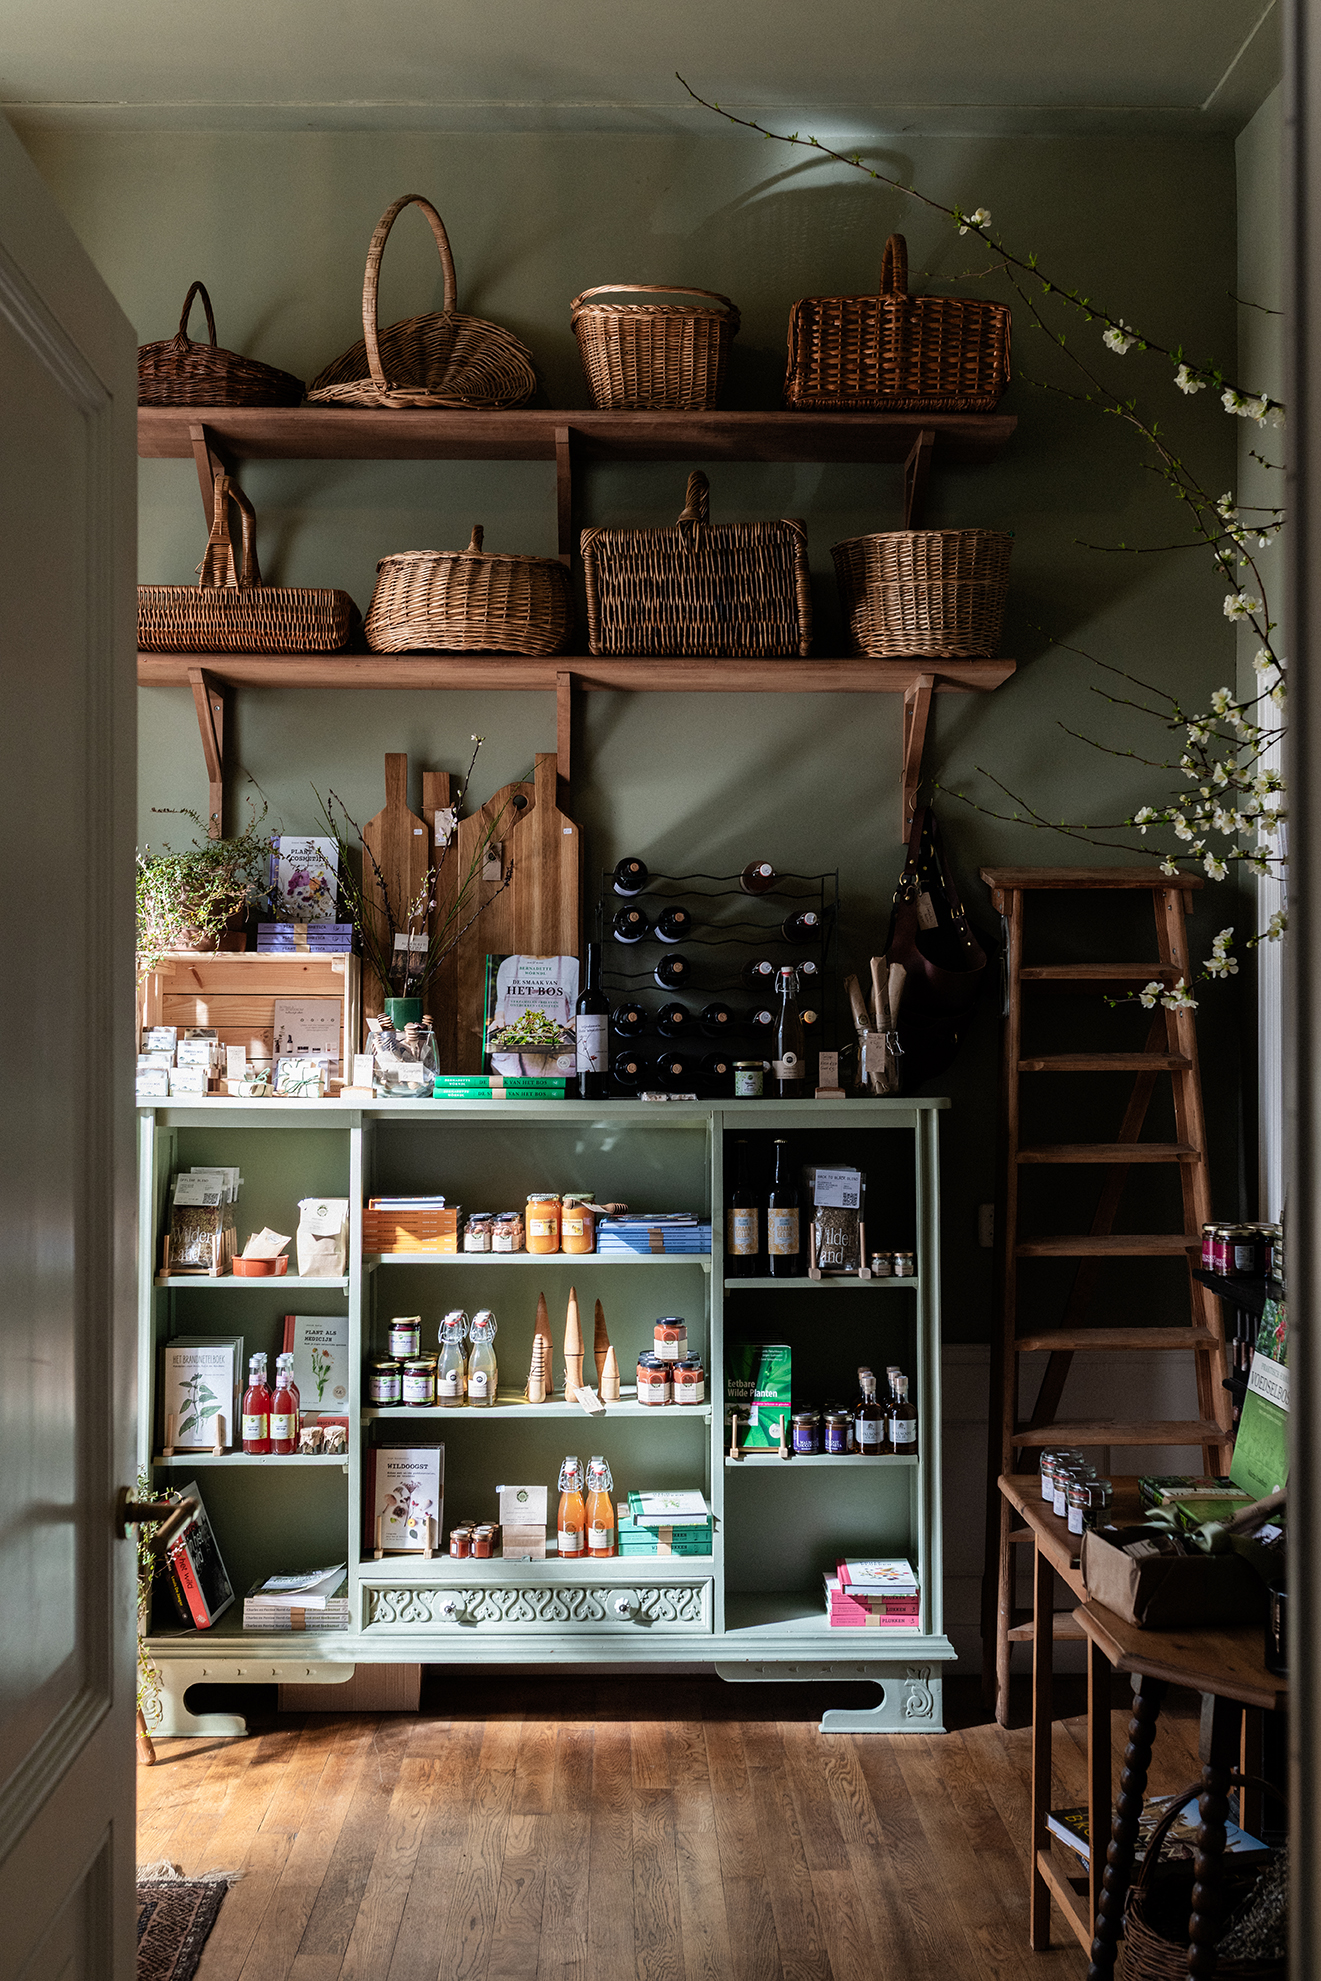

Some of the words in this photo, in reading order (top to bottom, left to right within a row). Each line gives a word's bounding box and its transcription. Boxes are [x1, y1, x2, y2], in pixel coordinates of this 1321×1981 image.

[507, 986, 534, 996] HET
[538, 986, 564, 996] BOS
[173, 1226, 212, 1244] Wilder
[171, 1244, 201, 1262] Land
[818, 1247, 844, 1264] and
[173, 1355, 182, 1364] HET
[183, 1355, 225, 1364] BRANDNETELBOEK
[728, 1380, 755, 1388] Eetbare
[728, 1388, 748, 1397] Wilde
[750, 1388, 778, 1397] Planten
[1251, 1371, 1290, 1406] VOEDSELBOS
[179, 1557, 188, 1571] het
[184, 1573, 193, 1589] wild
